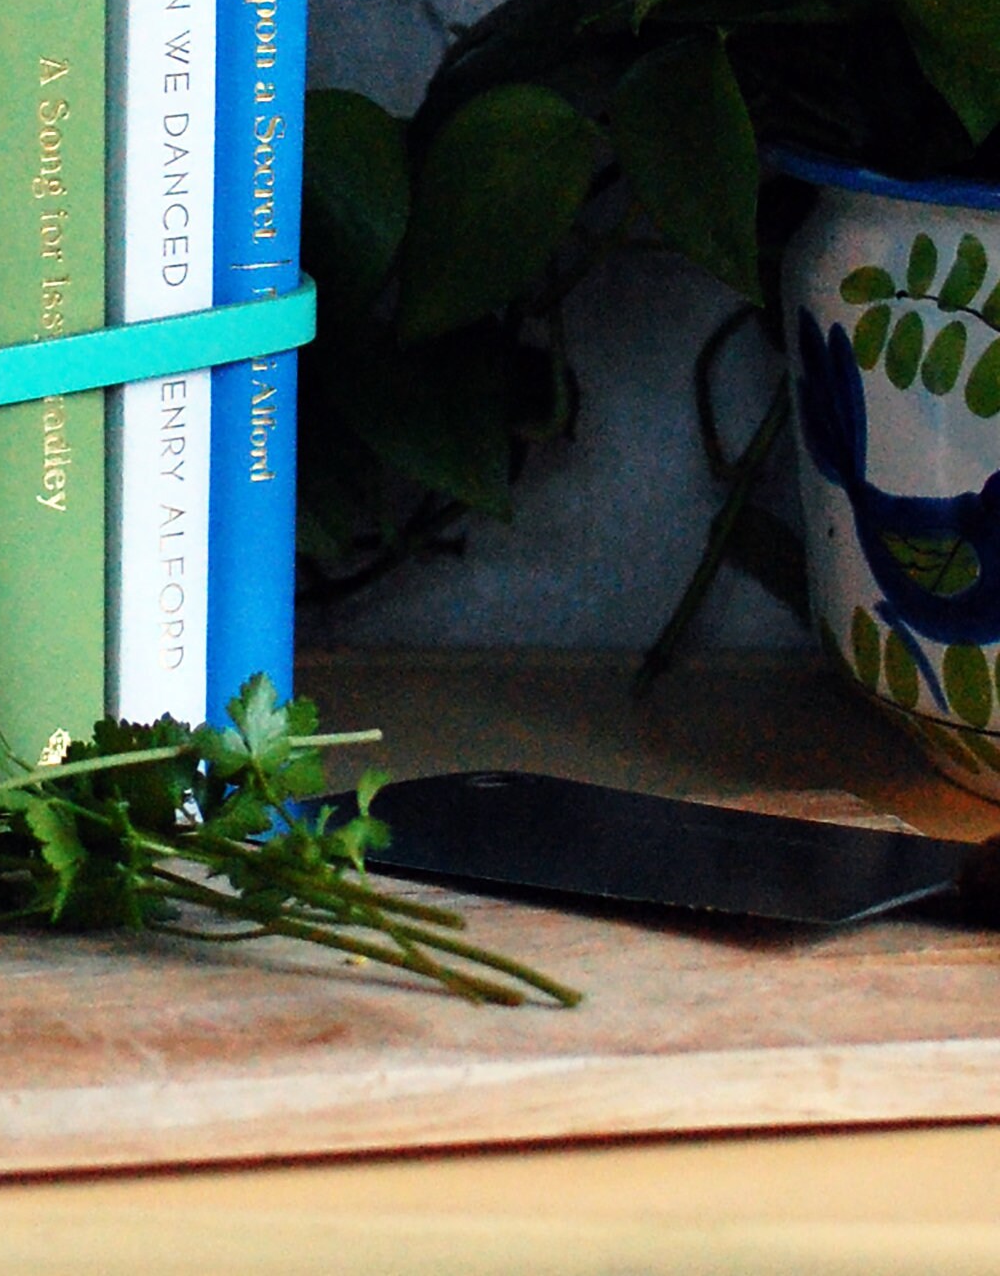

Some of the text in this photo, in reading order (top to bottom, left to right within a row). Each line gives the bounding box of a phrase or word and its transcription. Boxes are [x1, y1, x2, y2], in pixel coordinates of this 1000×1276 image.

[40, 56, 70, 87] A
[163, 30, 191, 94] WE
[254, 82, 276, 103] a
[32, 98, 70, 200] Song
[160, 113, 191, 288] DANCED
[251, 116, 287, 245] Secret
[38, 209, 70, 263] for
[35, 395, 72, 512] radley
[249, 380, 279, 484] Alford
[156, 379, 187, 672] ENRY ALFORD
